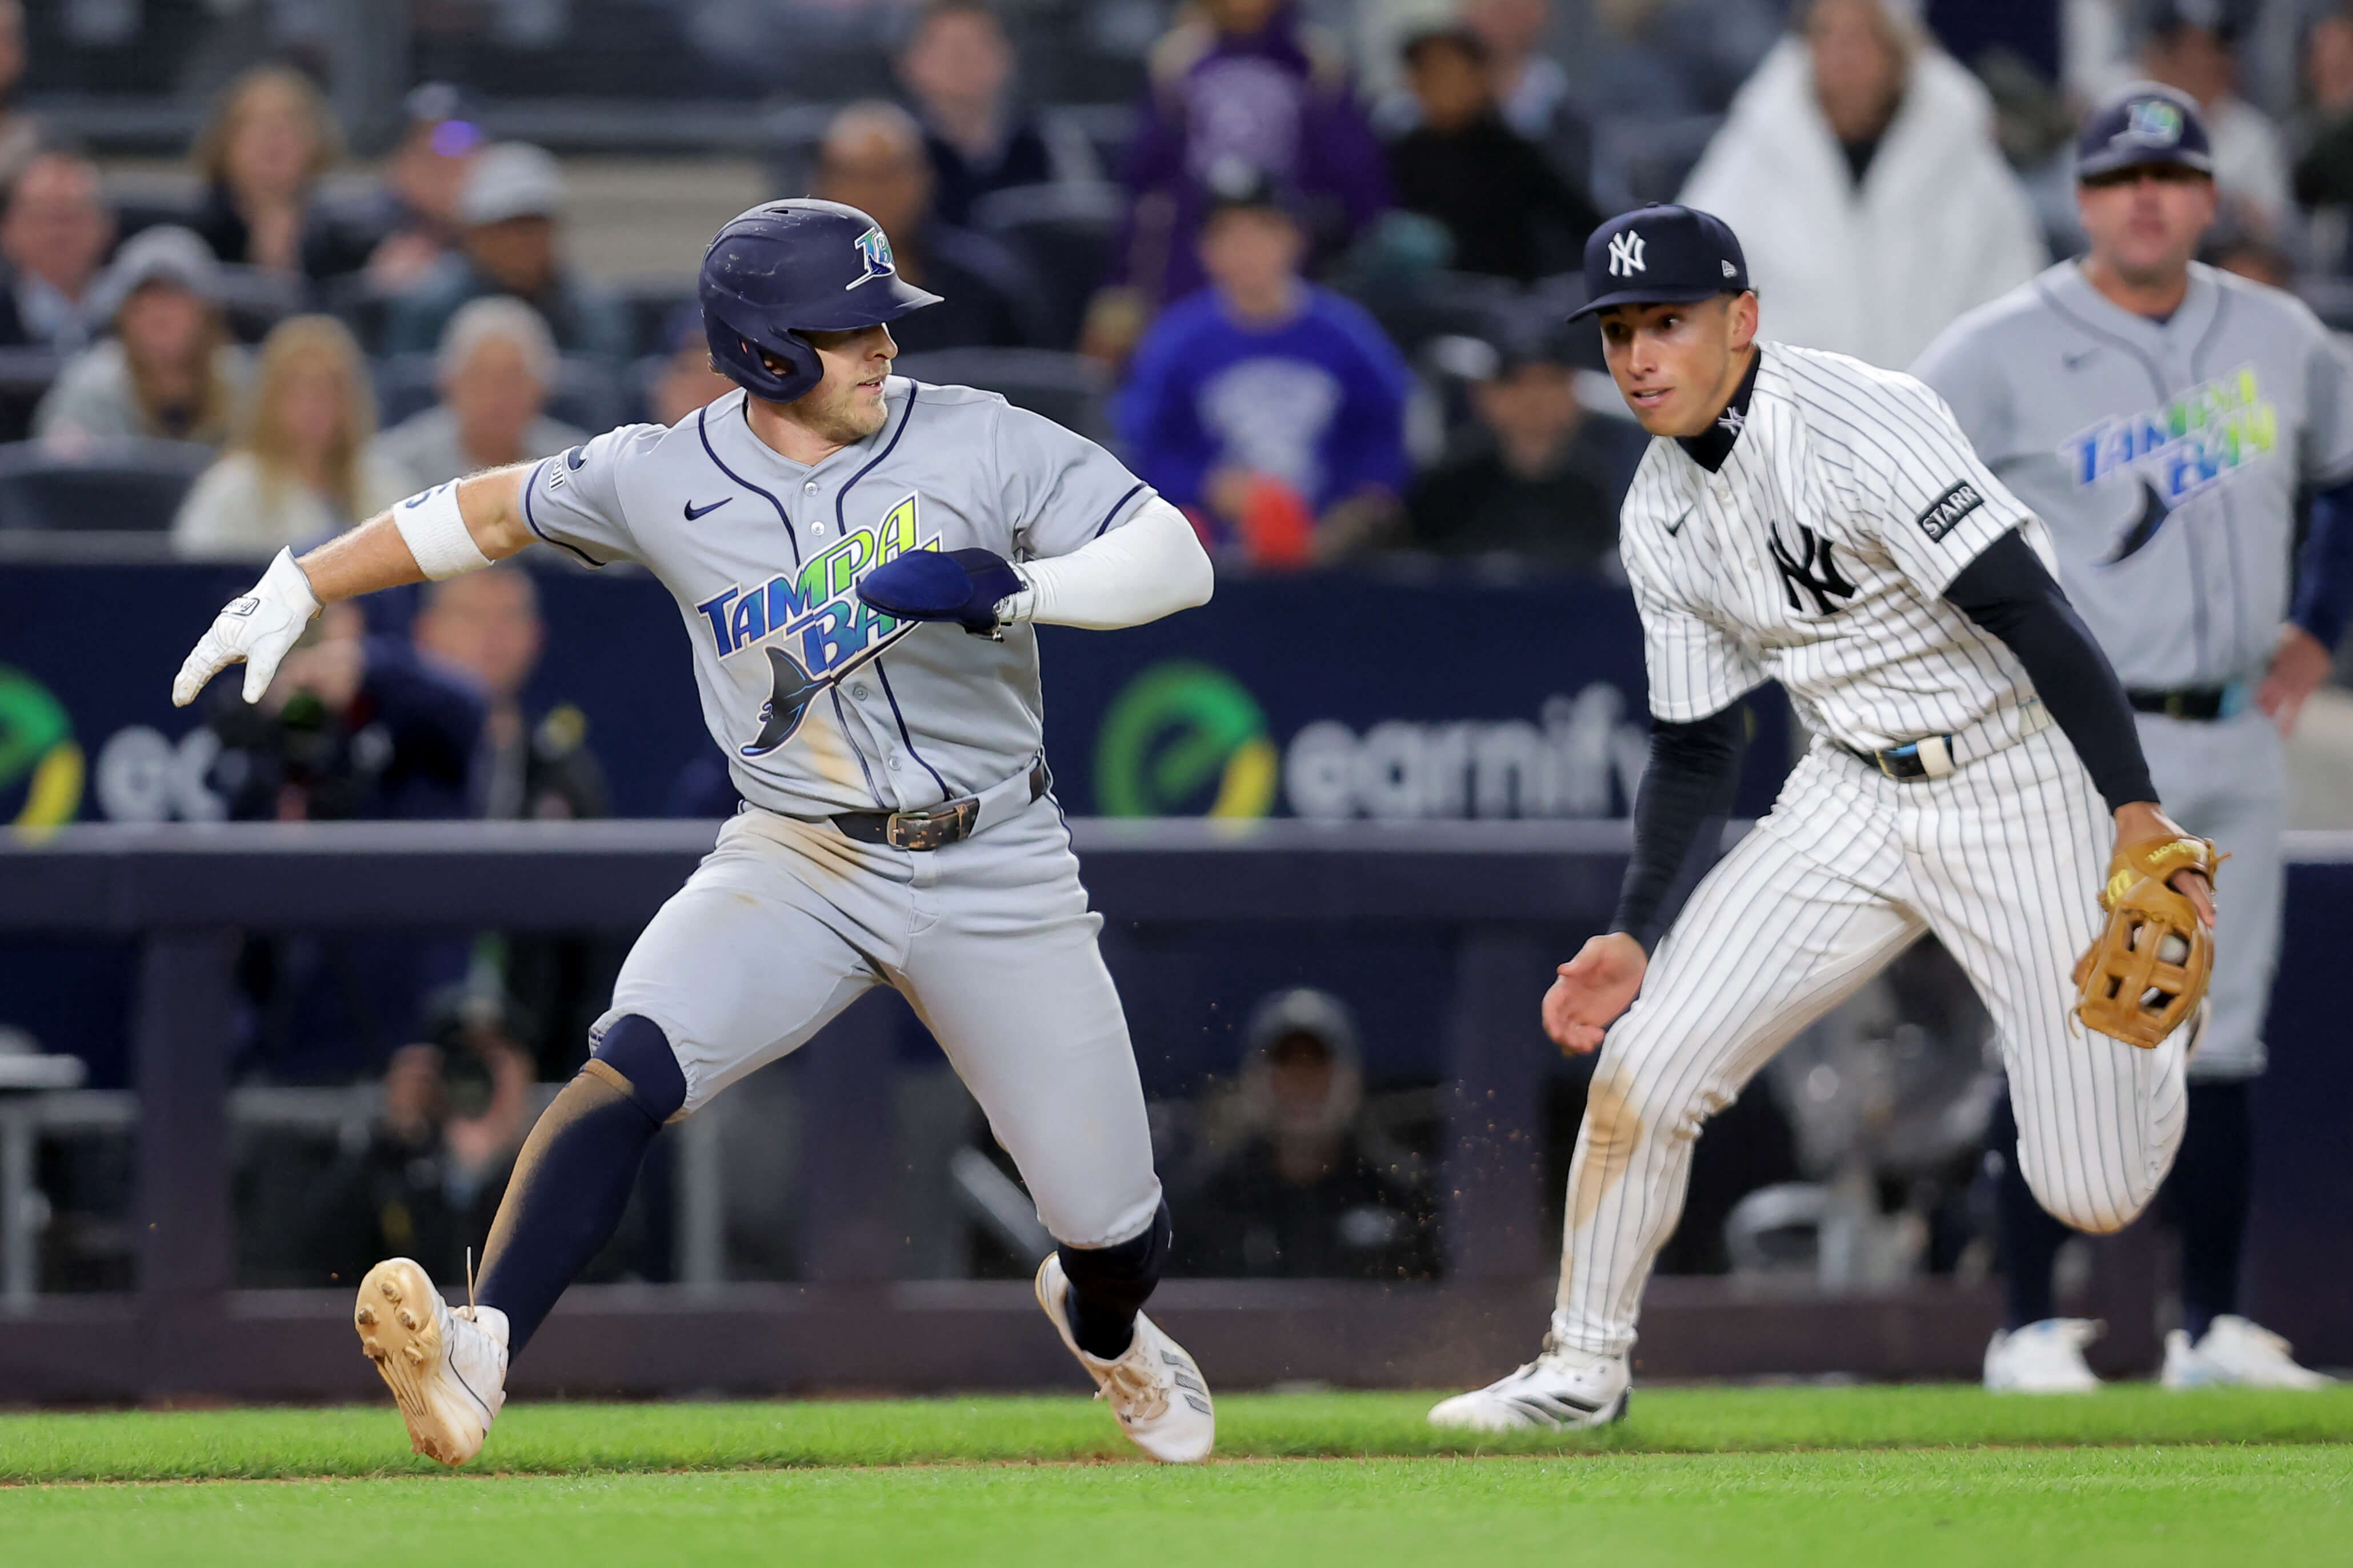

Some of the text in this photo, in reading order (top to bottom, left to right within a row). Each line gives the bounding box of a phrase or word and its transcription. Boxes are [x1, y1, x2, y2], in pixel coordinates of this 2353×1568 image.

[1608, 230, 1646, 276] NY
[1922, 486, 1979, 538] STARR
[695, 491, 918, 659] TAMPA
[784, 535, 941, 676] BA
